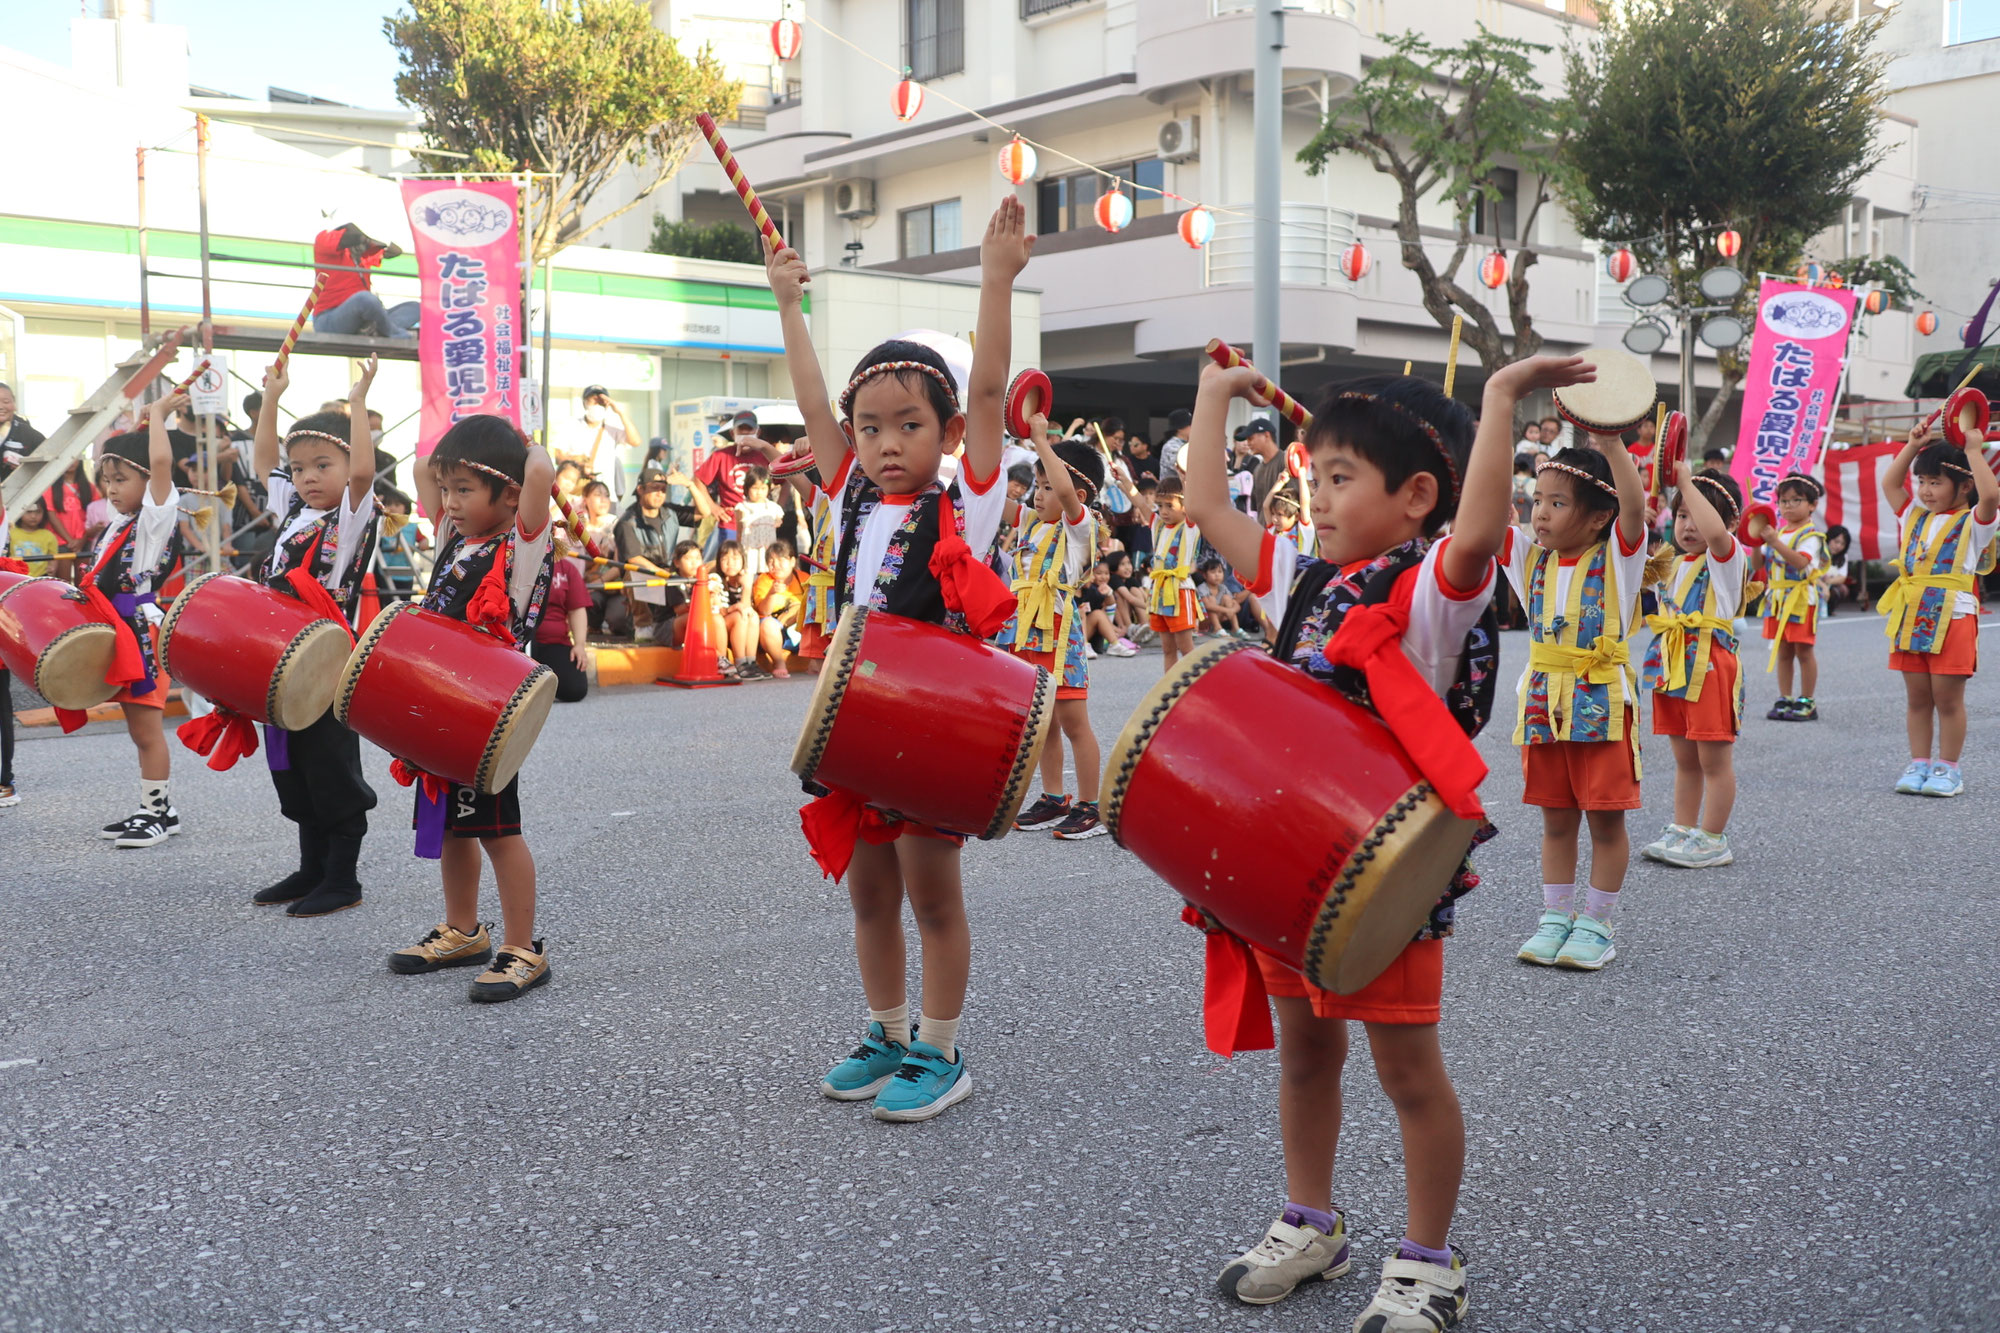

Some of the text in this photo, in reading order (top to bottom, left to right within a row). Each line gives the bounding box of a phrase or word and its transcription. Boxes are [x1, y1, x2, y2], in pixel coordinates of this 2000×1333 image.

[495, 304, 512, 409] 社会福祉法人
[1789, 390, 1825, 473] 社会福祉法人
